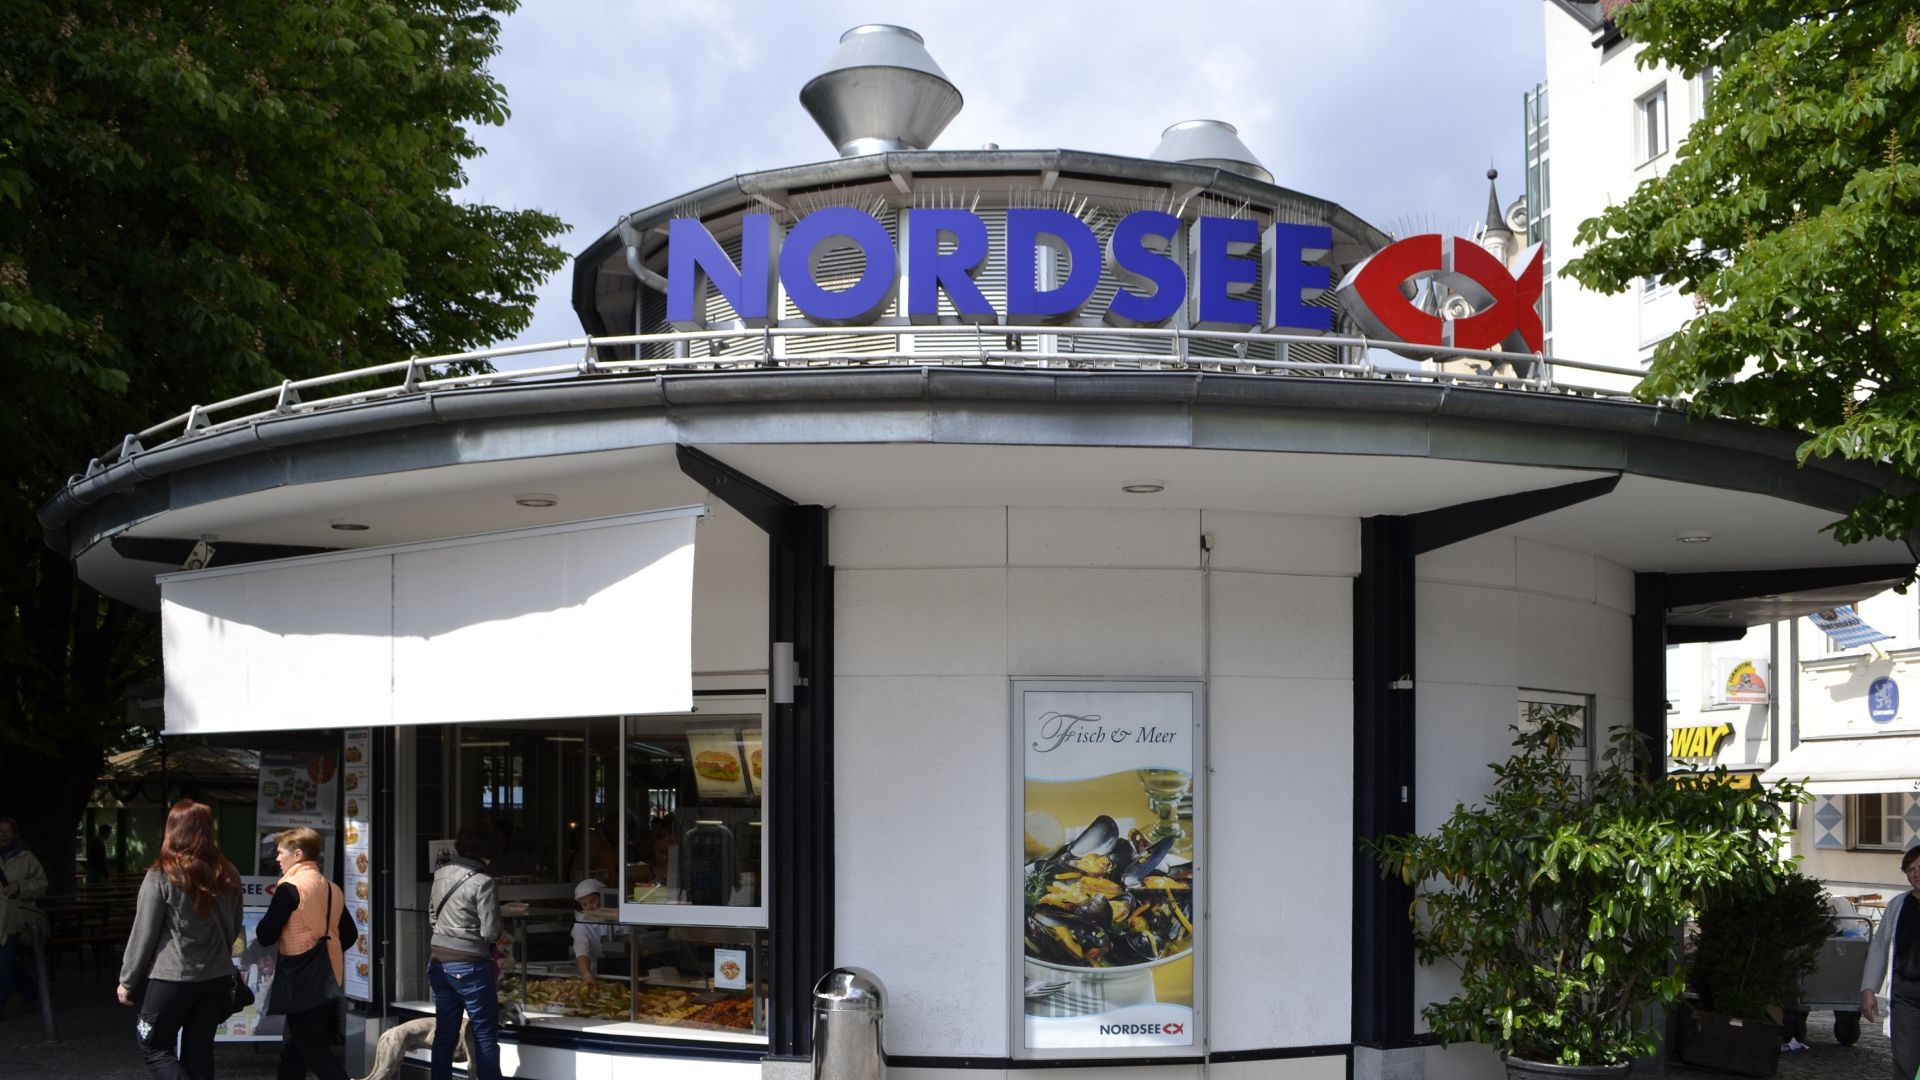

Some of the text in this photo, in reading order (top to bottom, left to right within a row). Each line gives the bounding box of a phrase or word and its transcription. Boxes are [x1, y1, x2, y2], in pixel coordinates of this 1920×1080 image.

[667, 206, 1334, 330] NORDSEE
[1032, 711, 1177, 753] Fisch & Meer
[1100, 1024, 1161, 1035] NORDSEE
